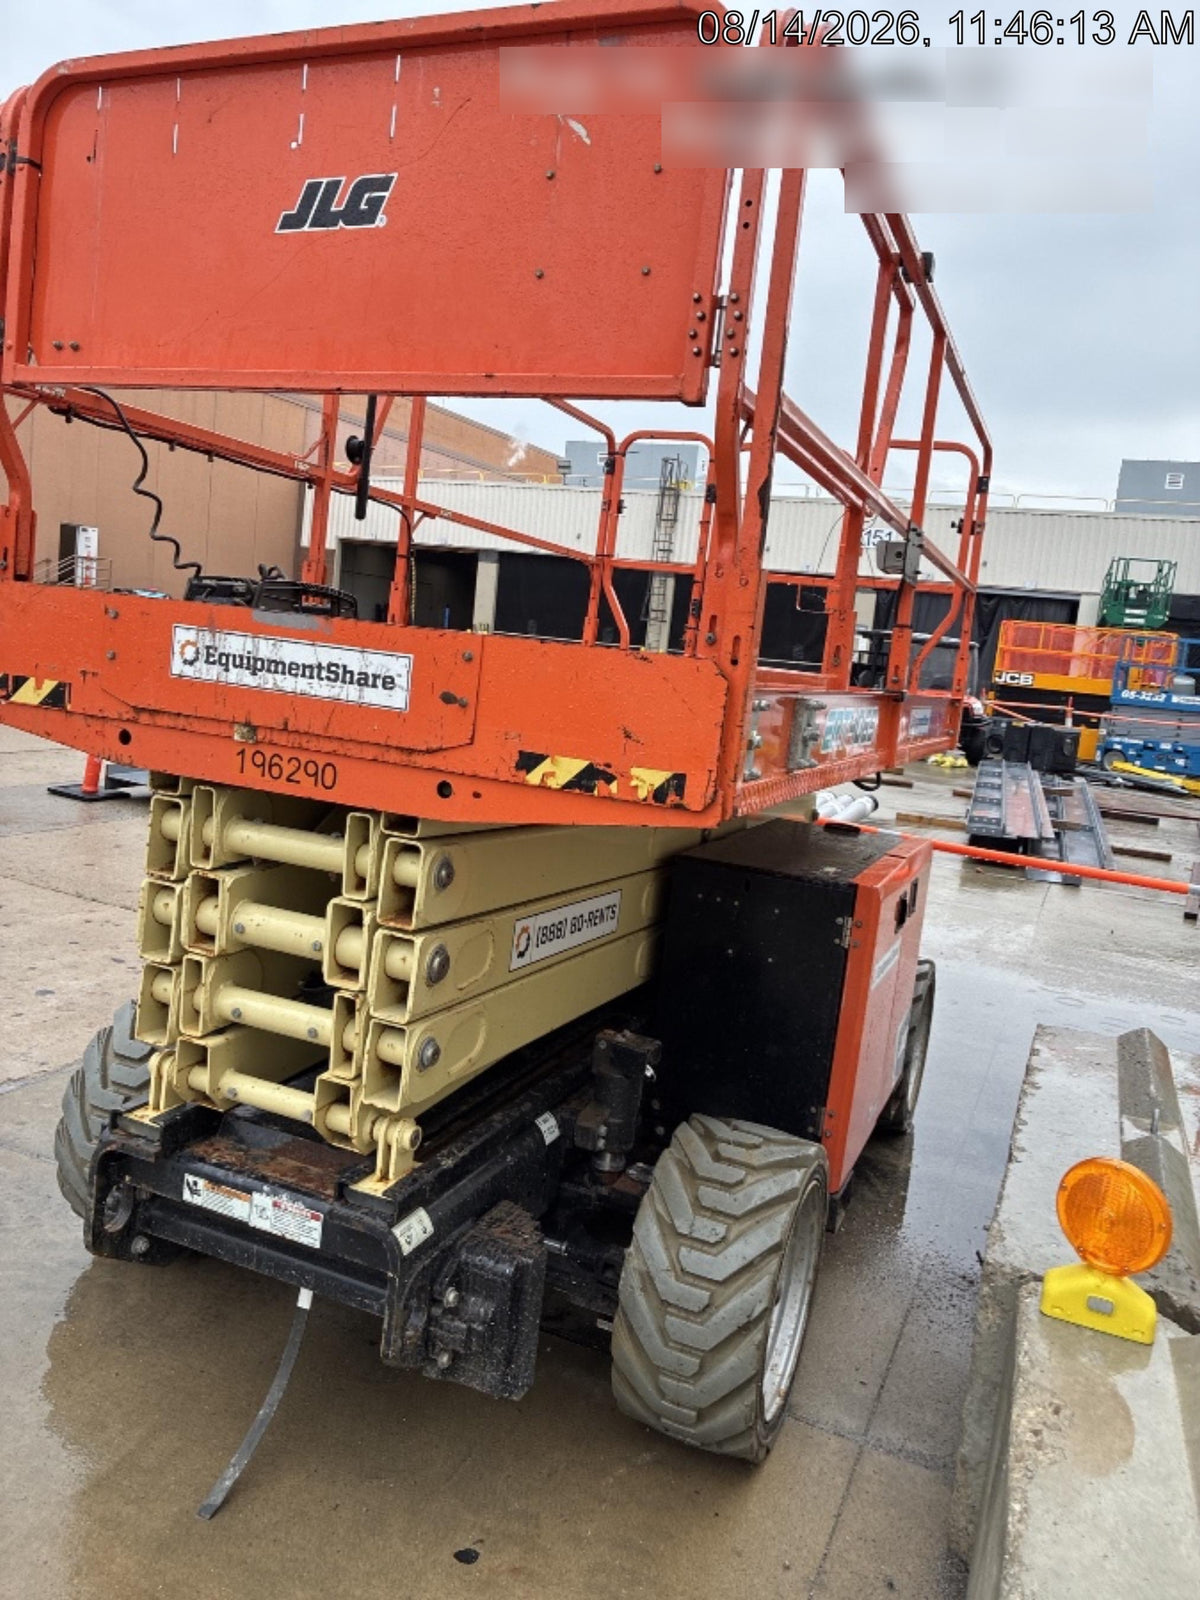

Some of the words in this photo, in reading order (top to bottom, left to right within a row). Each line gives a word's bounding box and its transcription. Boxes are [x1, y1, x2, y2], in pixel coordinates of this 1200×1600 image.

[275, 173, 397, 233] JLG
[204, 645, 396, 690] EquipmentShare
[994, 673, 1034, 686] JCB
[236, 748, 338, 790] 196290
[535, 918, 568, 948] (888)
